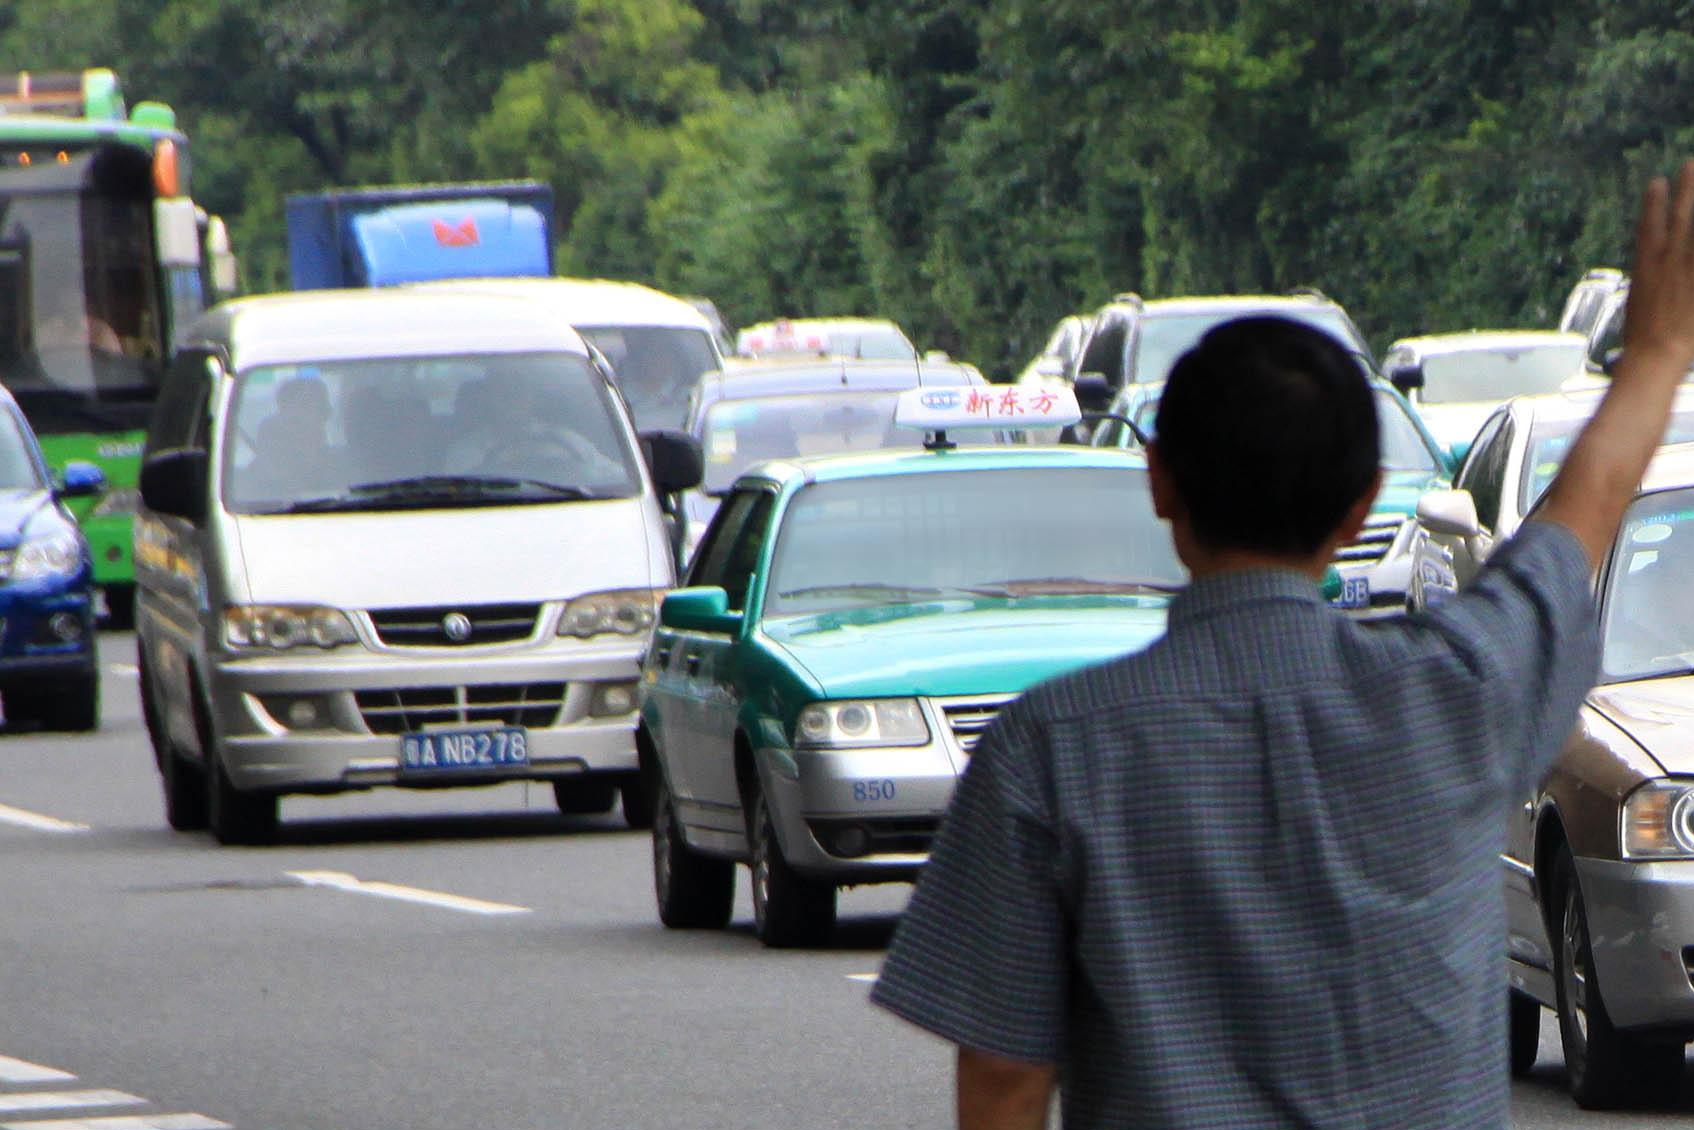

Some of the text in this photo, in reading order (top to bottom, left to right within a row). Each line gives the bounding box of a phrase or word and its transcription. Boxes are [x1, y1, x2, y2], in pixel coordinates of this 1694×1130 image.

[965, 387, 1057, 419] 新东方
[854, 779, 894, 801] 850
